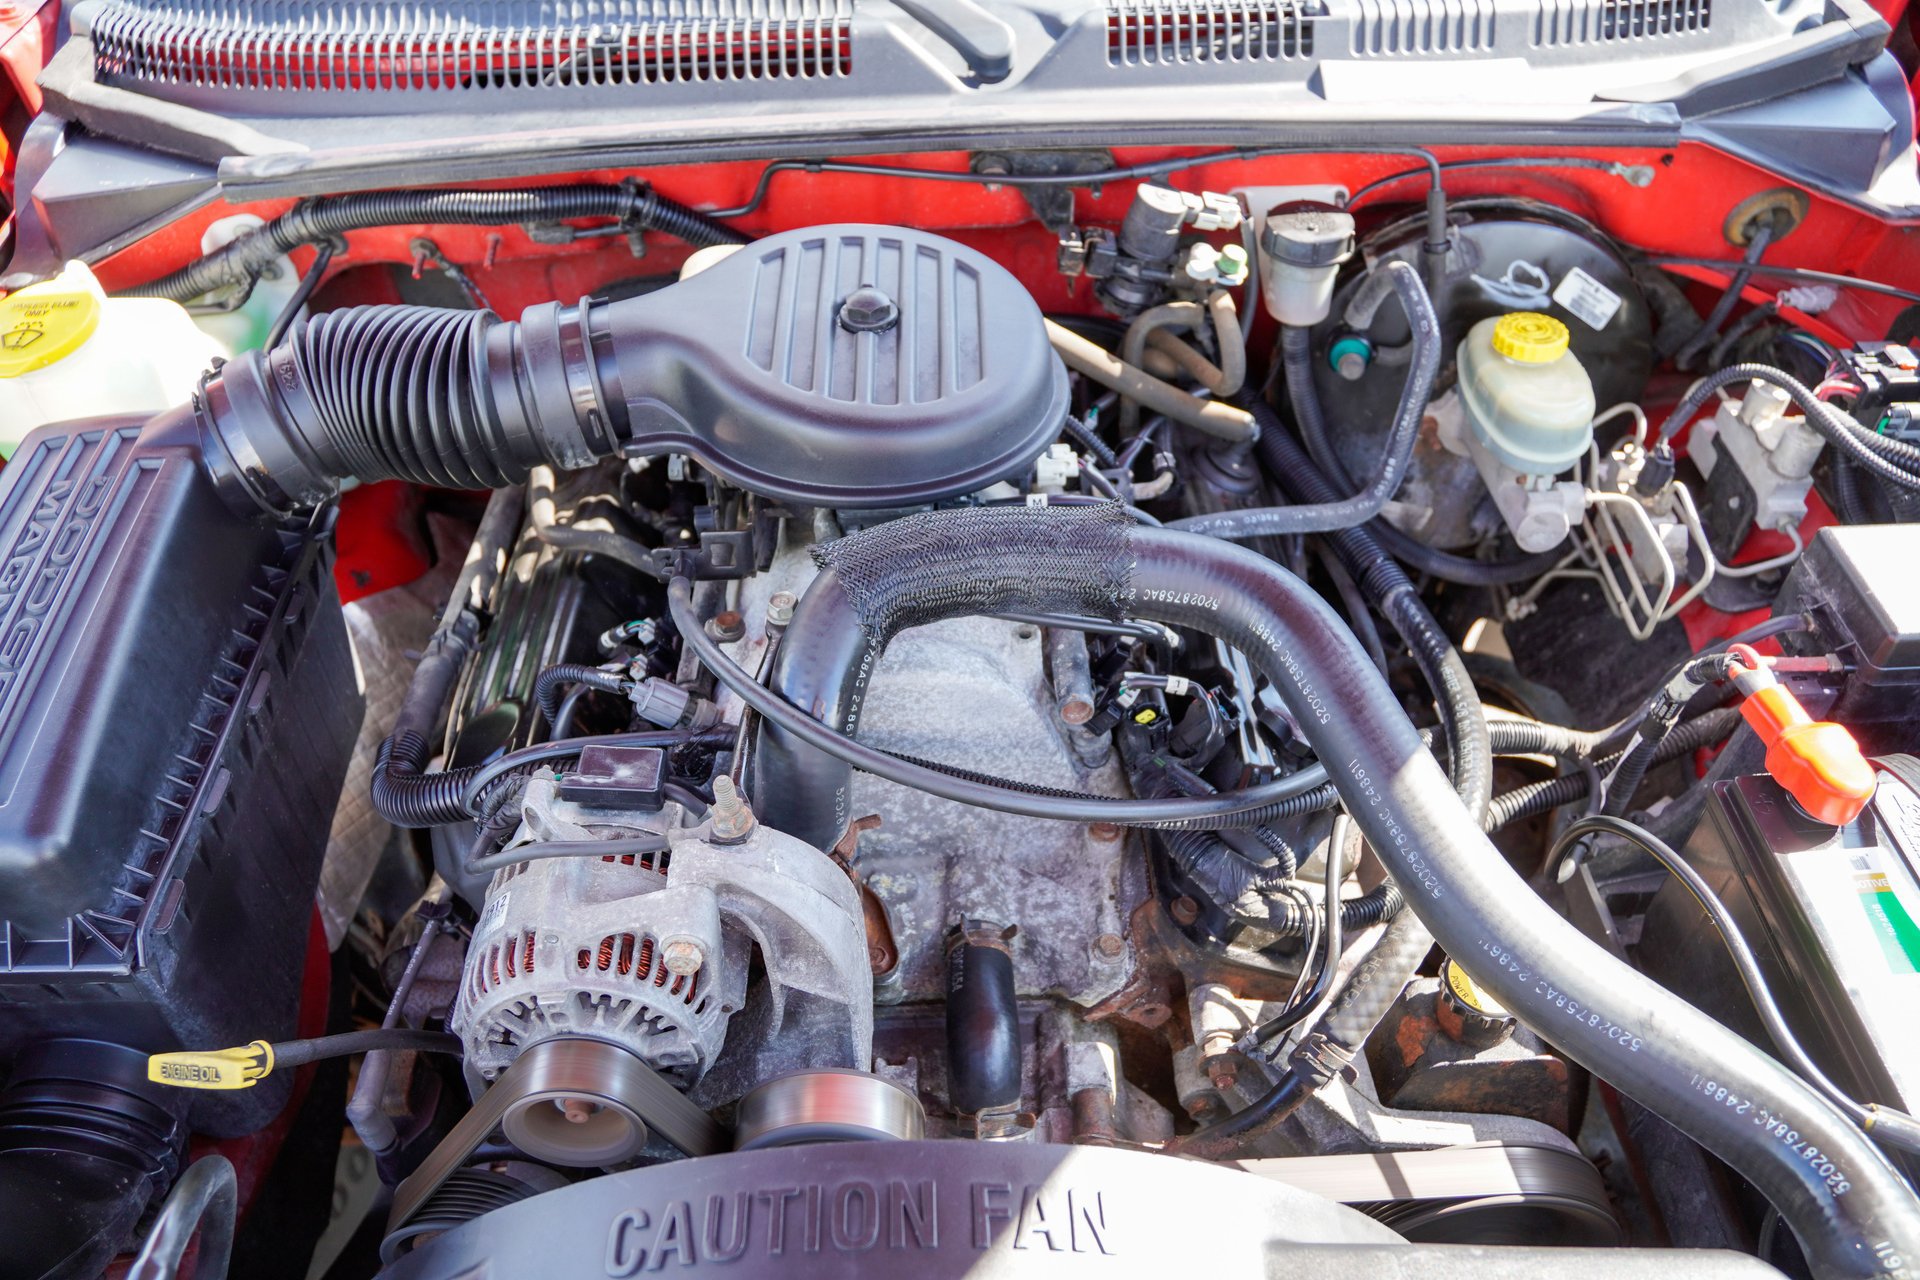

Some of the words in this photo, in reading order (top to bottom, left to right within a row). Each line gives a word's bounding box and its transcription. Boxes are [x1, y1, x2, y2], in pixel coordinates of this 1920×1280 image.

[1279, 649, 1332, 725] 52028758AC
[1450, 973, 1469, 999] POWER
[160, 1062, 199, 1081] ENGINE
[199, 1065, 221, 1082] OIL
[605, 1178, 939, 1274] CAUTION
[970, 1180, 1117, 1256] FAN
